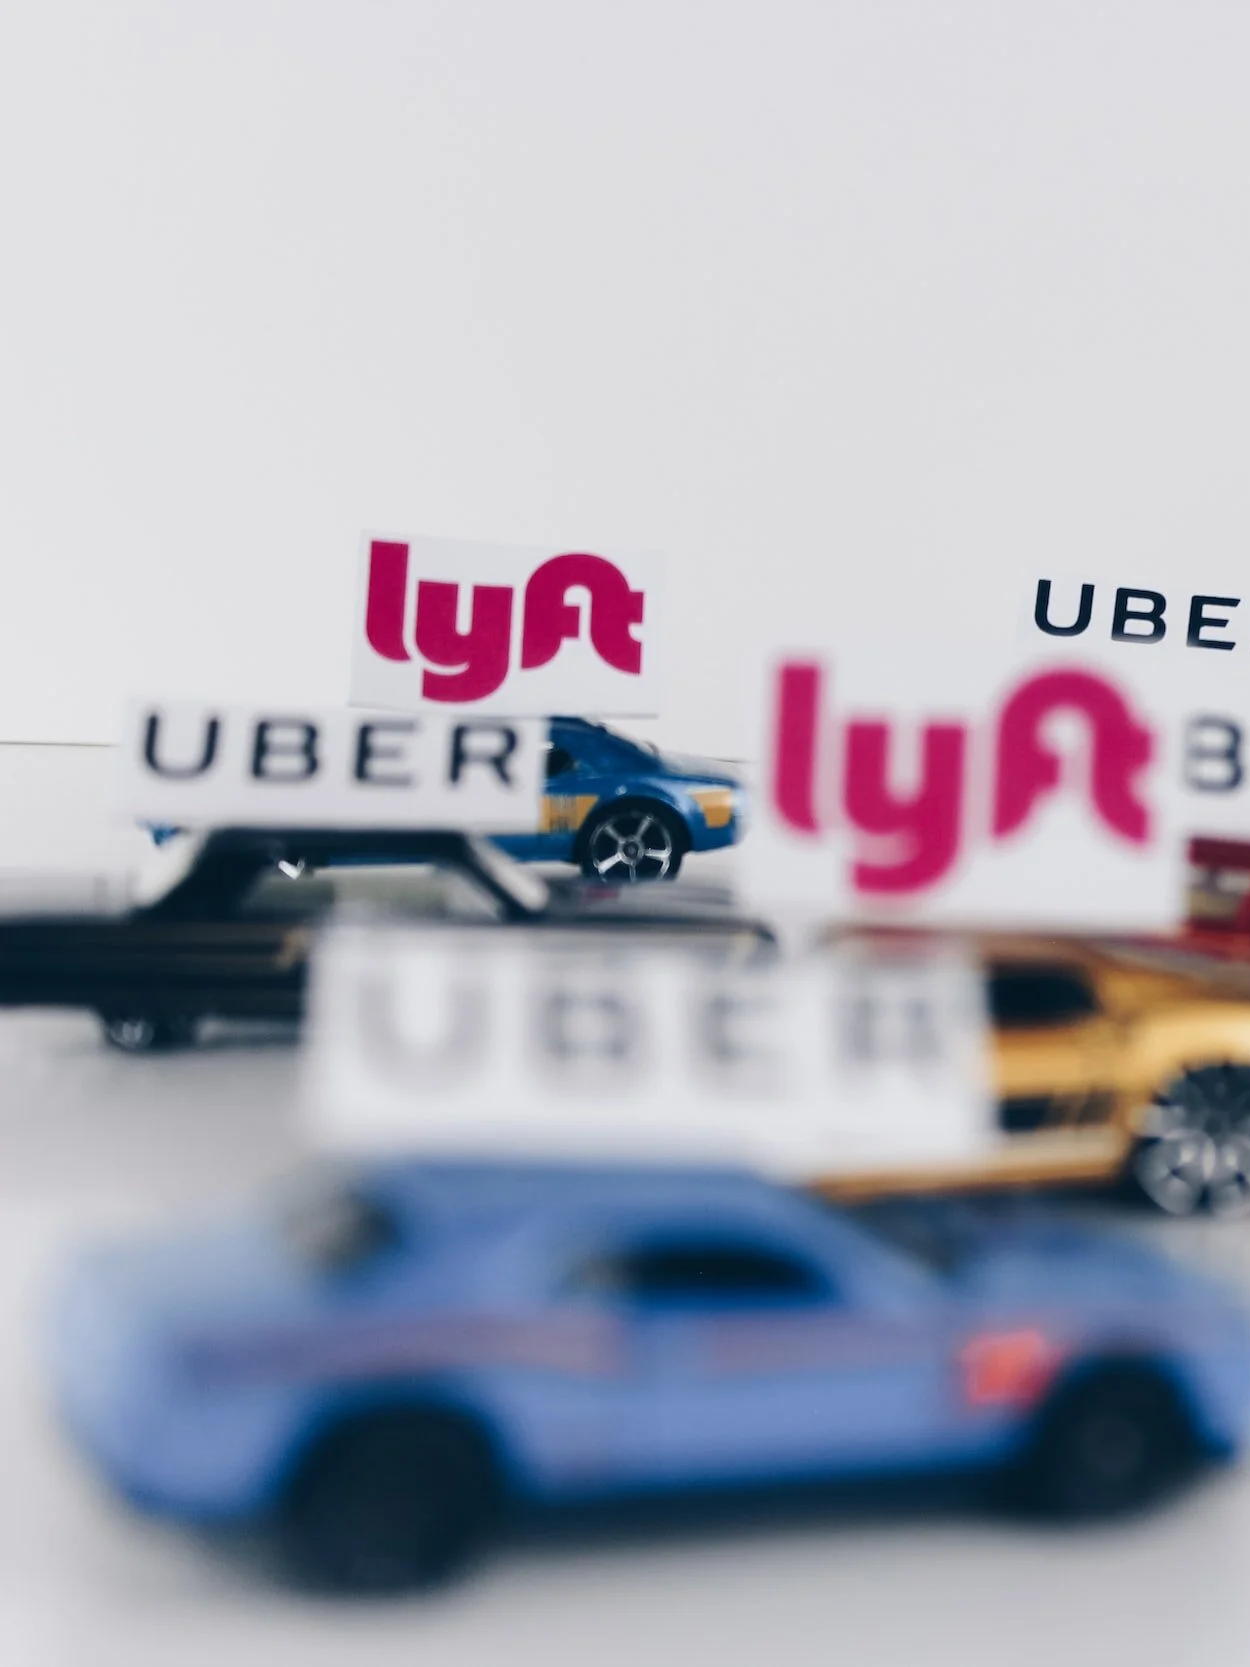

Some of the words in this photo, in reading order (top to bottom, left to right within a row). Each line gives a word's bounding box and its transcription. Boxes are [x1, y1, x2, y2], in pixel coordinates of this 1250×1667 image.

[365, 540, 645, 703] lyft
[142, 713, 521, 788] UBER
[771, 660, 1155, 898] lyft
